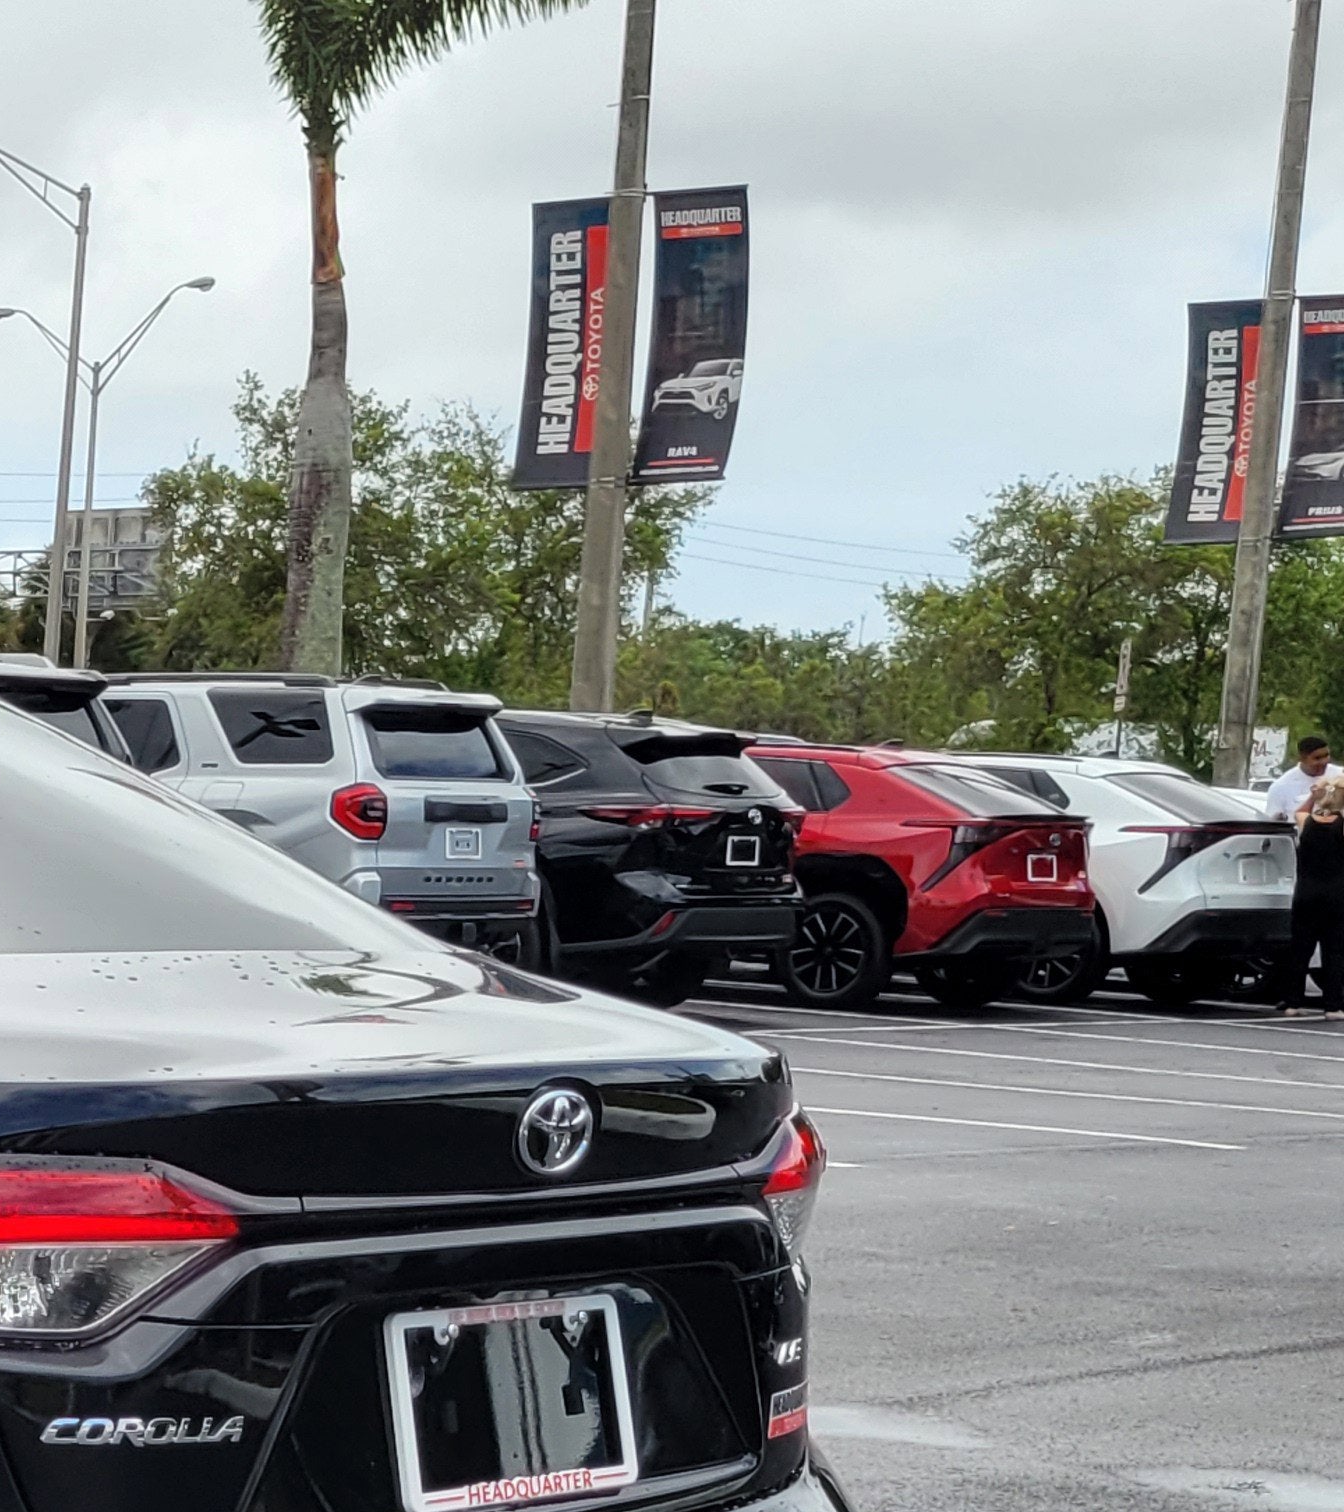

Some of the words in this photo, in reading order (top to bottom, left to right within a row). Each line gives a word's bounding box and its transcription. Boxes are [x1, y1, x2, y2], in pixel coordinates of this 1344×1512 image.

[660, 206, 742, 227] HEADQUARTER
[536, 230, 582, 455] HEADQUARTER
[585, 287, 605, 372] TOYOTA
[1187, 328, 1239, 522] HEADQUARTER
[1239, 380, 1258, 454] TOYOTA
[39, 1415, 245, 1447] COROLLA
[468, 1469, 594, 1506] HEADQUARTER
